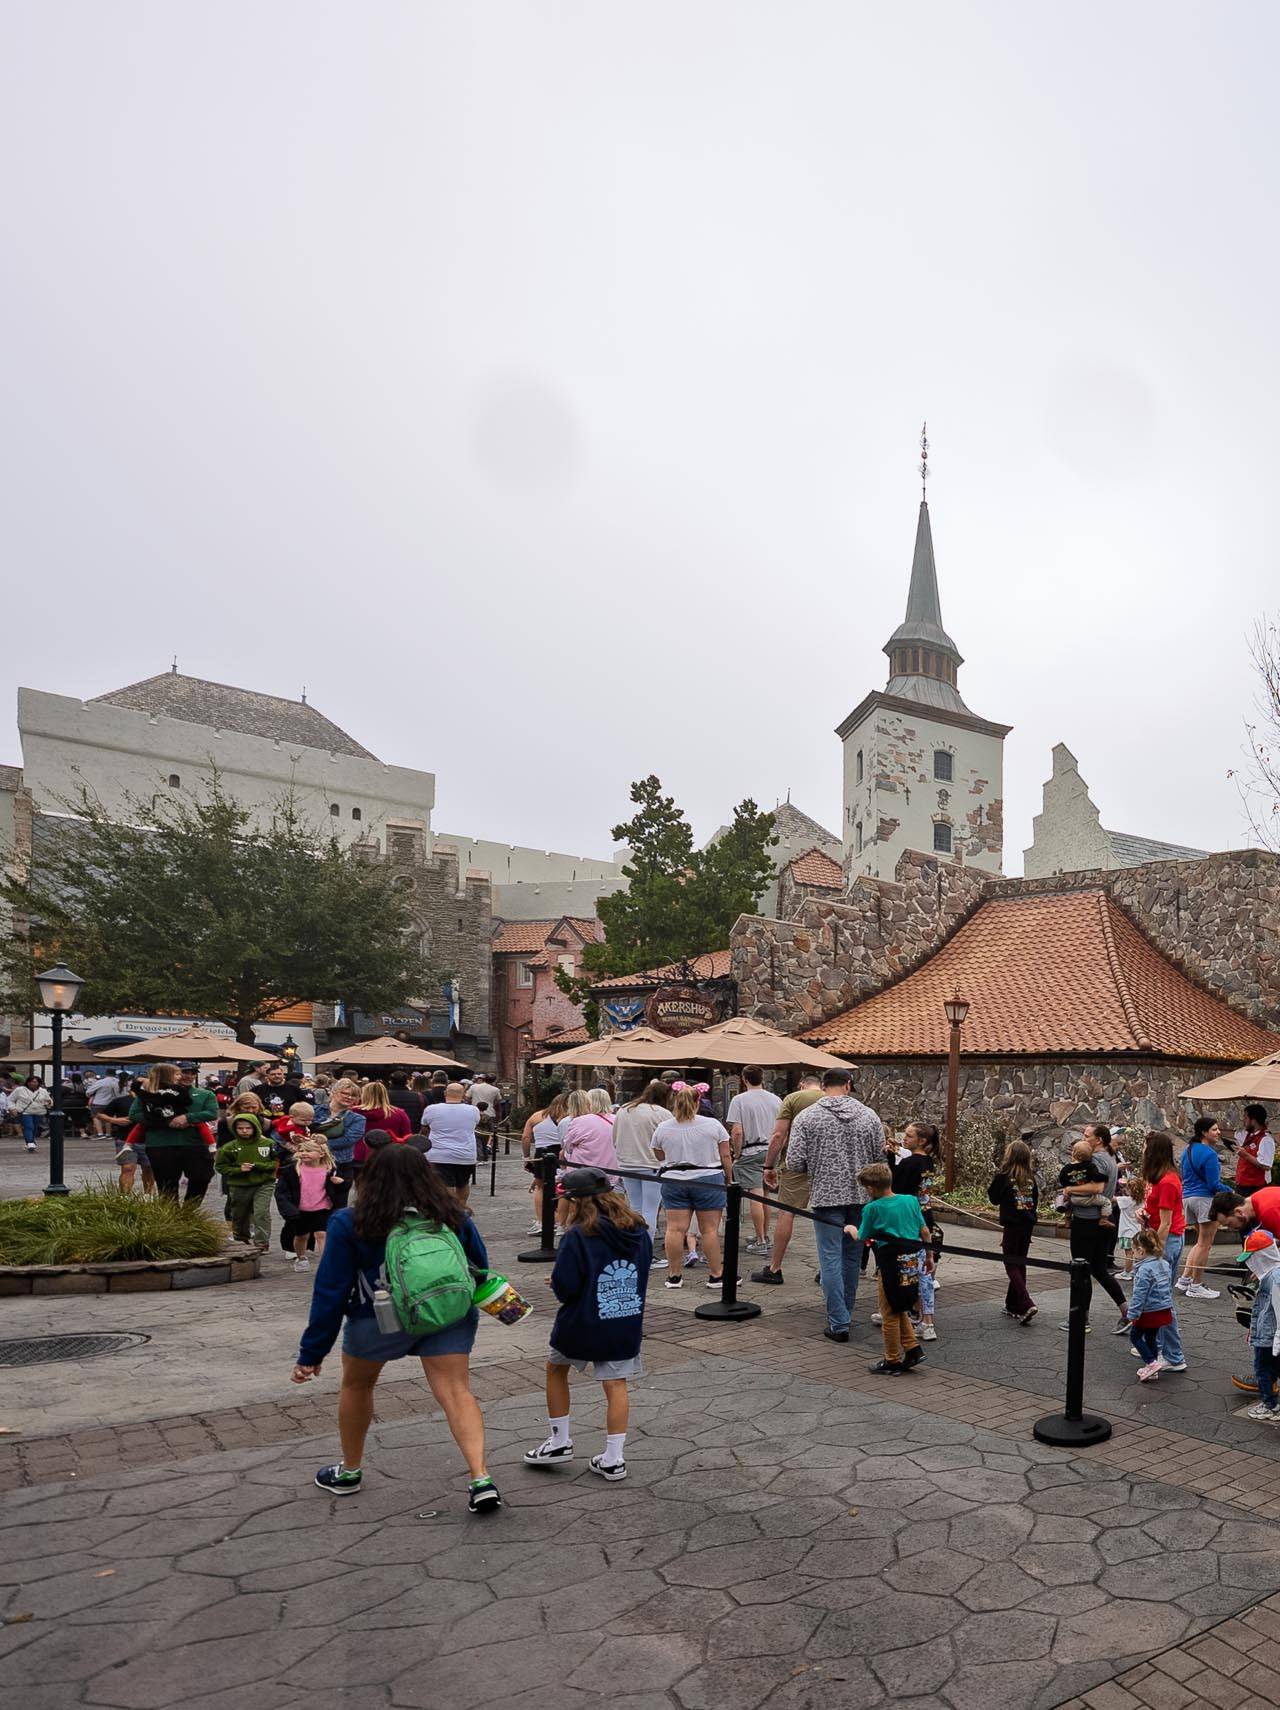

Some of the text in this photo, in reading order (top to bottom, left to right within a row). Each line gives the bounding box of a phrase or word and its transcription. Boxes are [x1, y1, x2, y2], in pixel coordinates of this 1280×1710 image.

[657, 1001, 713, 1019] AKERSHUS
[381, 1016, 423, 1025] FROZEN
[598, 1299, 620, 1313] 25
